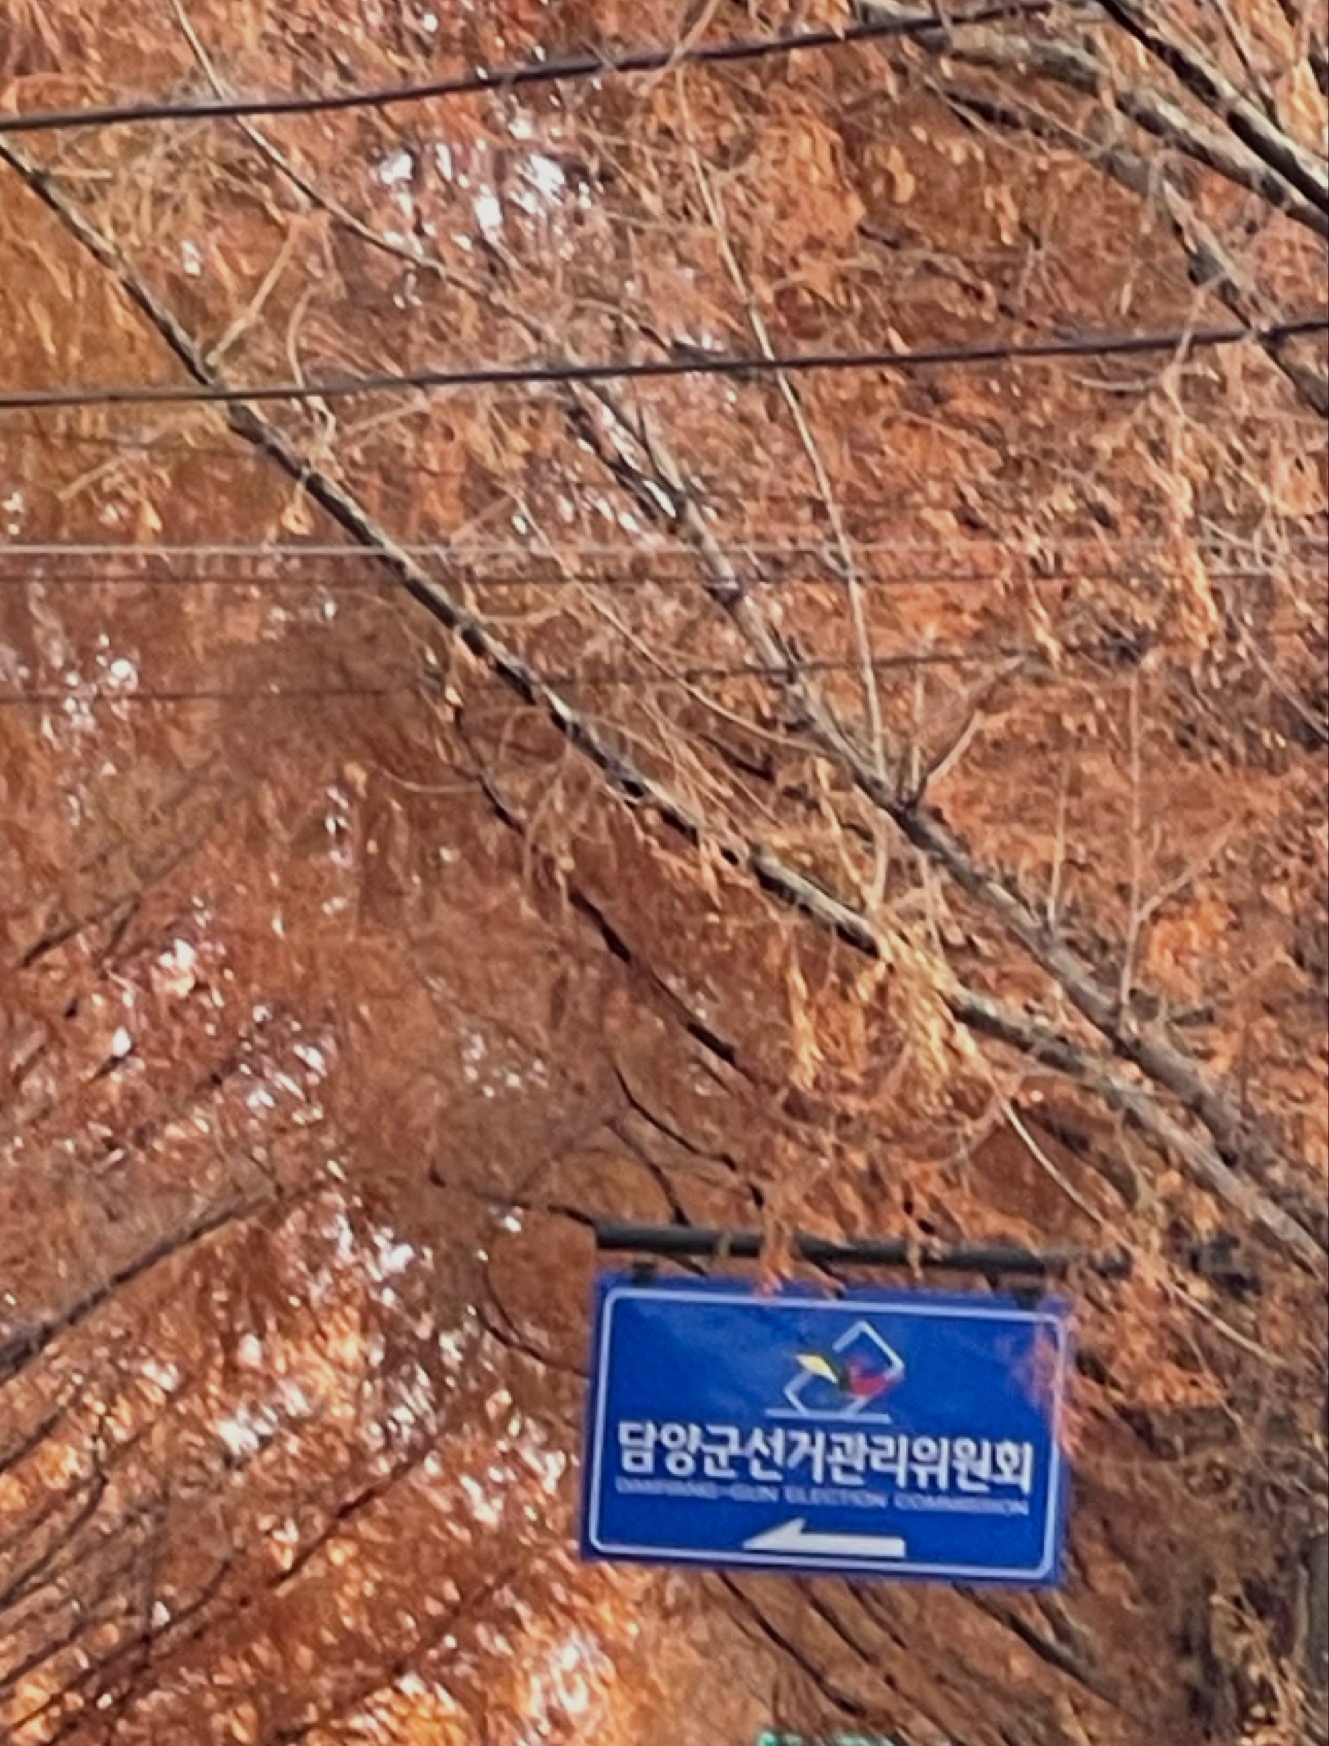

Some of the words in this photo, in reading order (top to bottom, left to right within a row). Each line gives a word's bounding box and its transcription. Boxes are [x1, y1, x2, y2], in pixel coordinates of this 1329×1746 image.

[617, 1419, 1032, 1496] 담양군선거관리위원회
[784, 1484, 888, 1509] ELECTION
[893, 1490, 1030, 1517] COMMISSION
